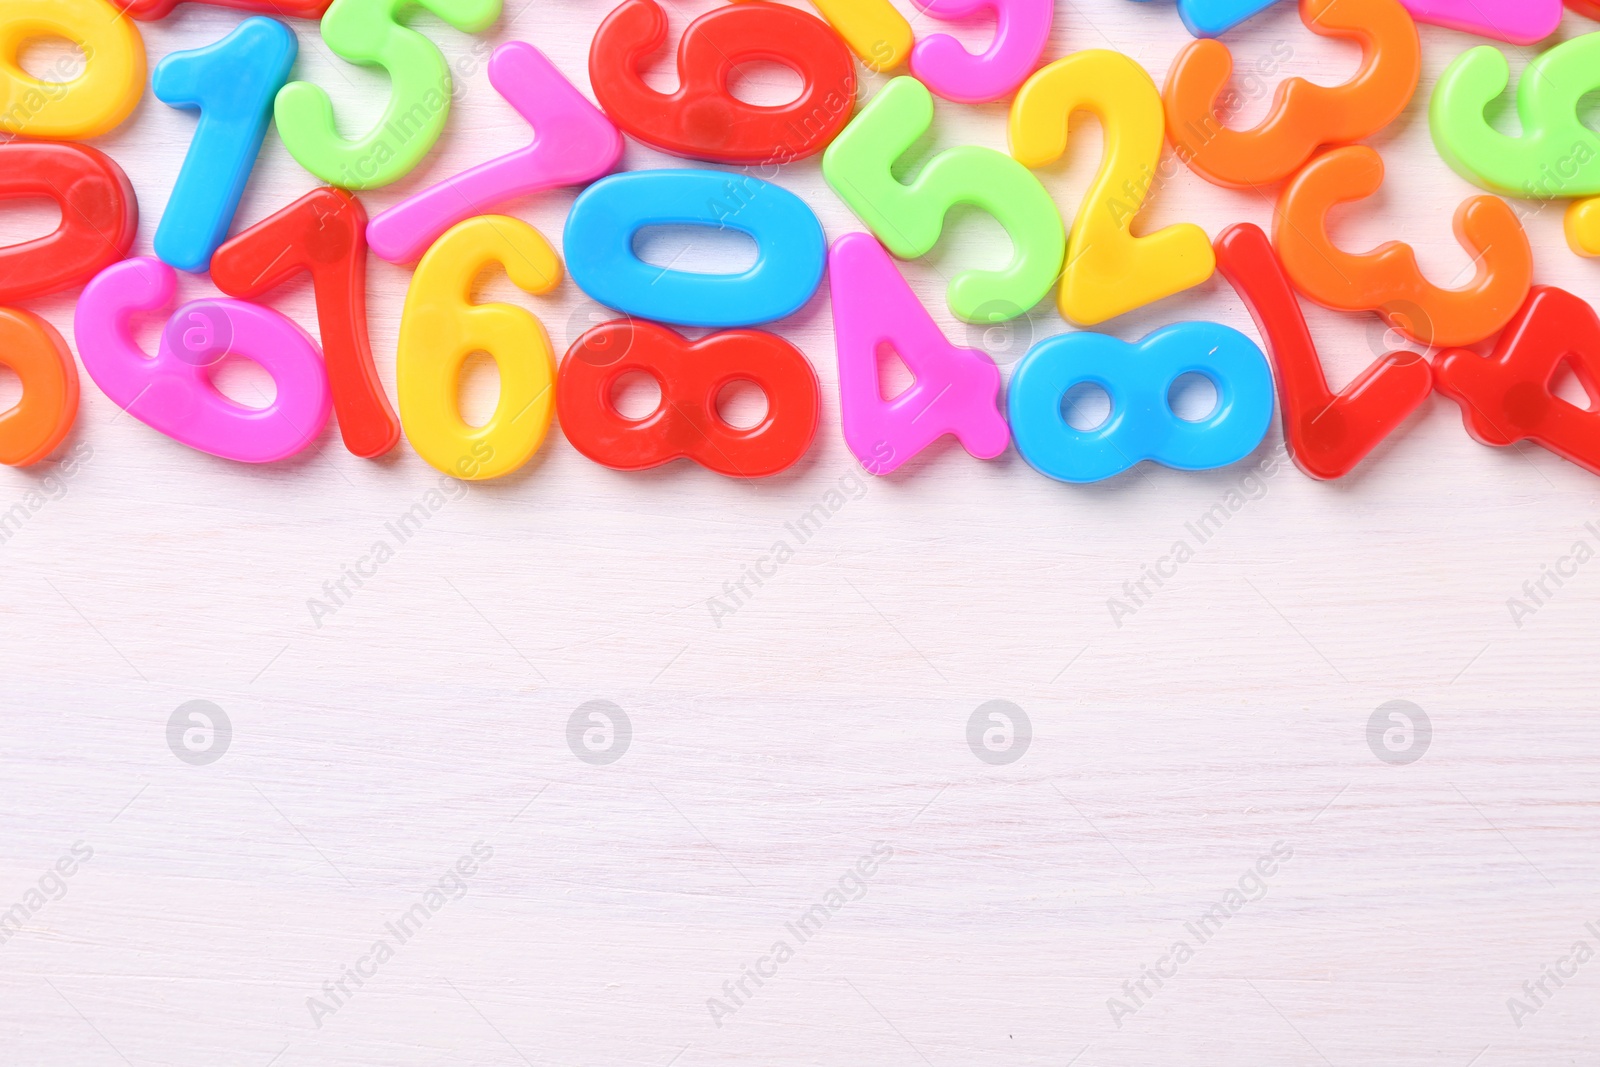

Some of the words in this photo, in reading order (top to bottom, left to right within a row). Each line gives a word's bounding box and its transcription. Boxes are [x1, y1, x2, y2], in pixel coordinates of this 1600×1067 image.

[153, 16, 298, 272] 1
[563, 169, 827, 327] 0
[823, 75, 1065, 324] 5
[1009, 49, 1216, 326] 2
[397, 214, 563, 479] 6
[557, 318, 821, 477] 8
[828, 232, 1010, 475] 4
[1008, 321, 1274, 483] 8
